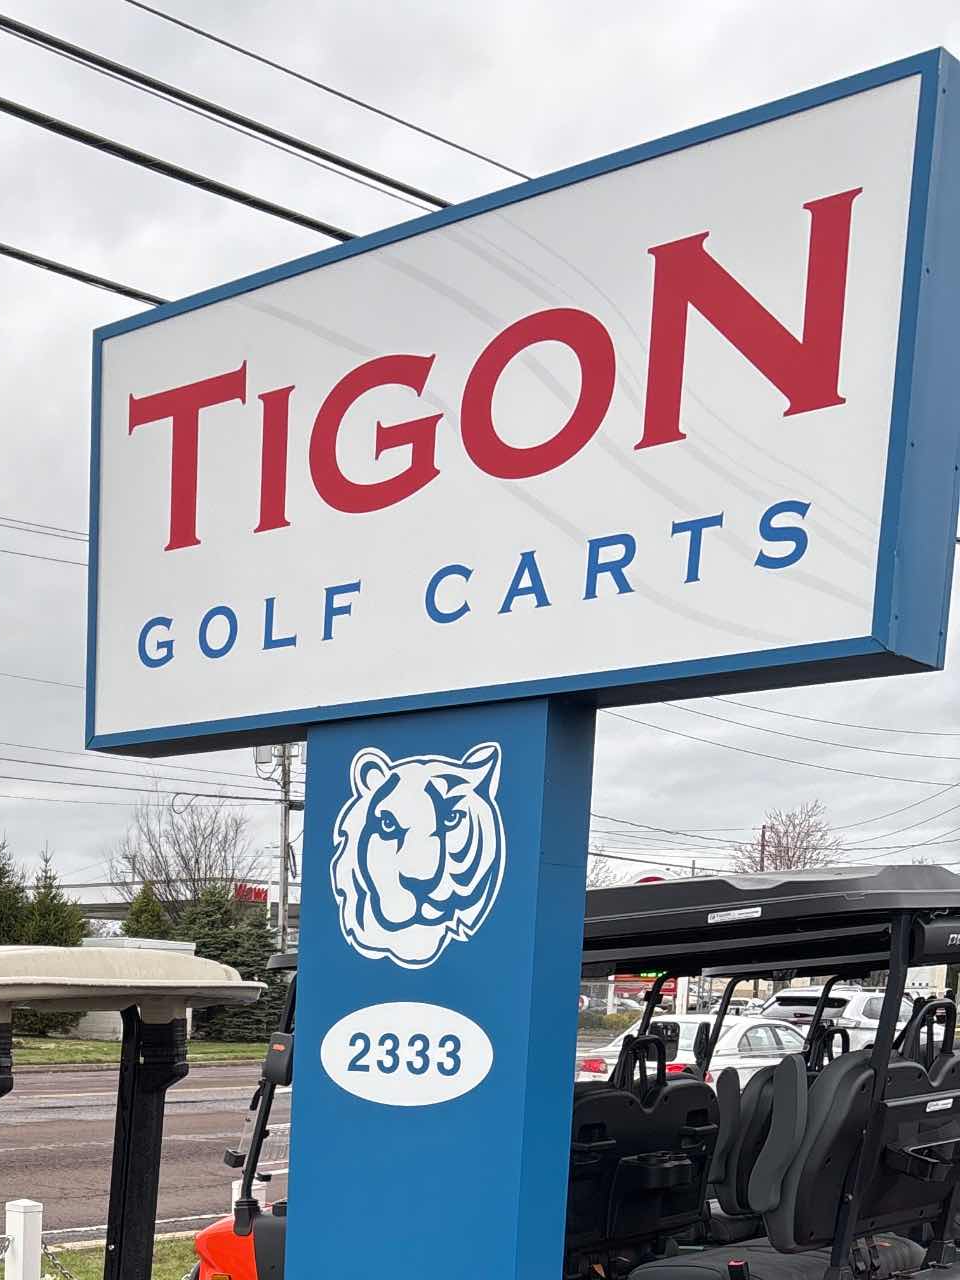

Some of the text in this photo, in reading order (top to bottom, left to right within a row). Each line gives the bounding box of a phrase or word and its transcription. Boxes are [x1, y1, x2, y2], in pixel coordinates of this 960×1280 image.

[129, 189, 859, 550] TIGON
[138, 500, 810, 669] GOLF CARTS
[347, 1032, 461, 1077] 2333
